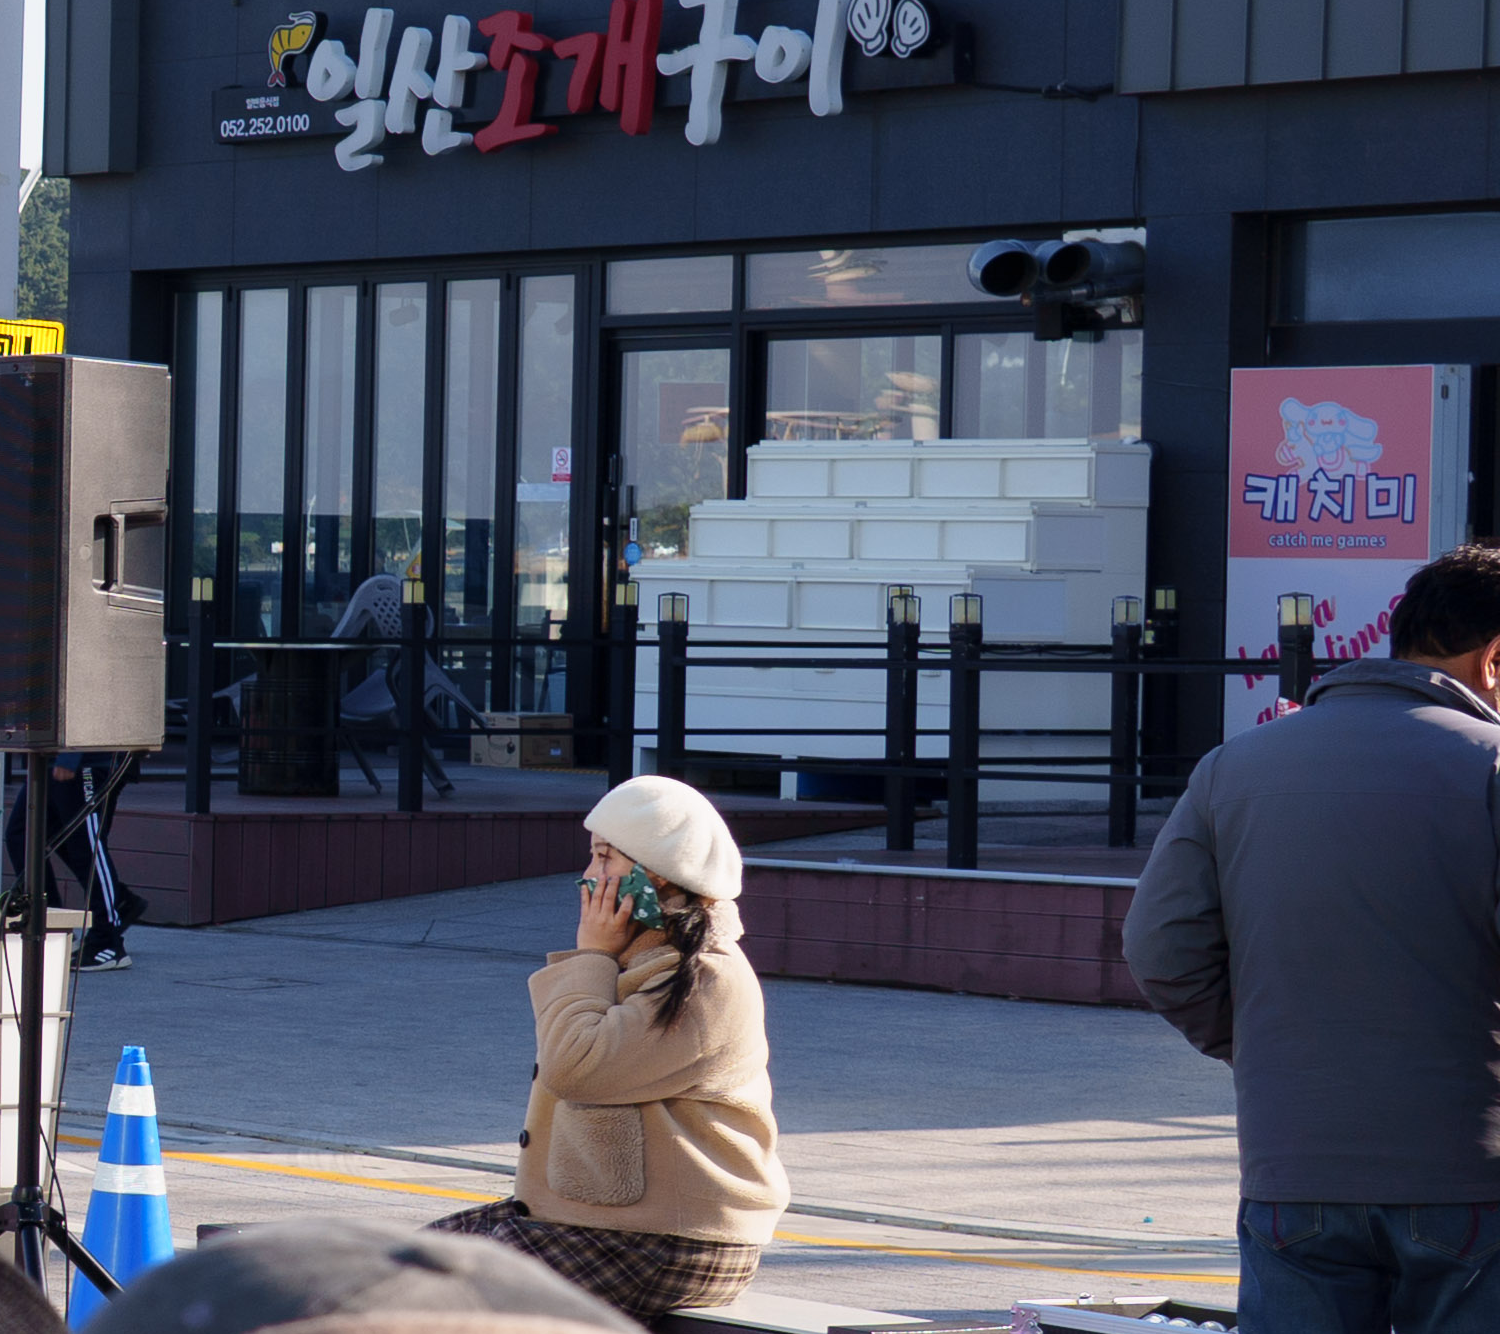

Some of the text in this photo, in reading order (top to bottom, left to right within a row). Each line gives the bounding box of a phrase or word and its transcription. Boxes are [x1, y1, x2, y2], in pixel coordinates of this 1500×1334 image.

[220, 114, 310, 138] 052.252.0100
[1244, 468, 1417, 524] 캐치미
[1269, 533, 1387, 549] catch me games
